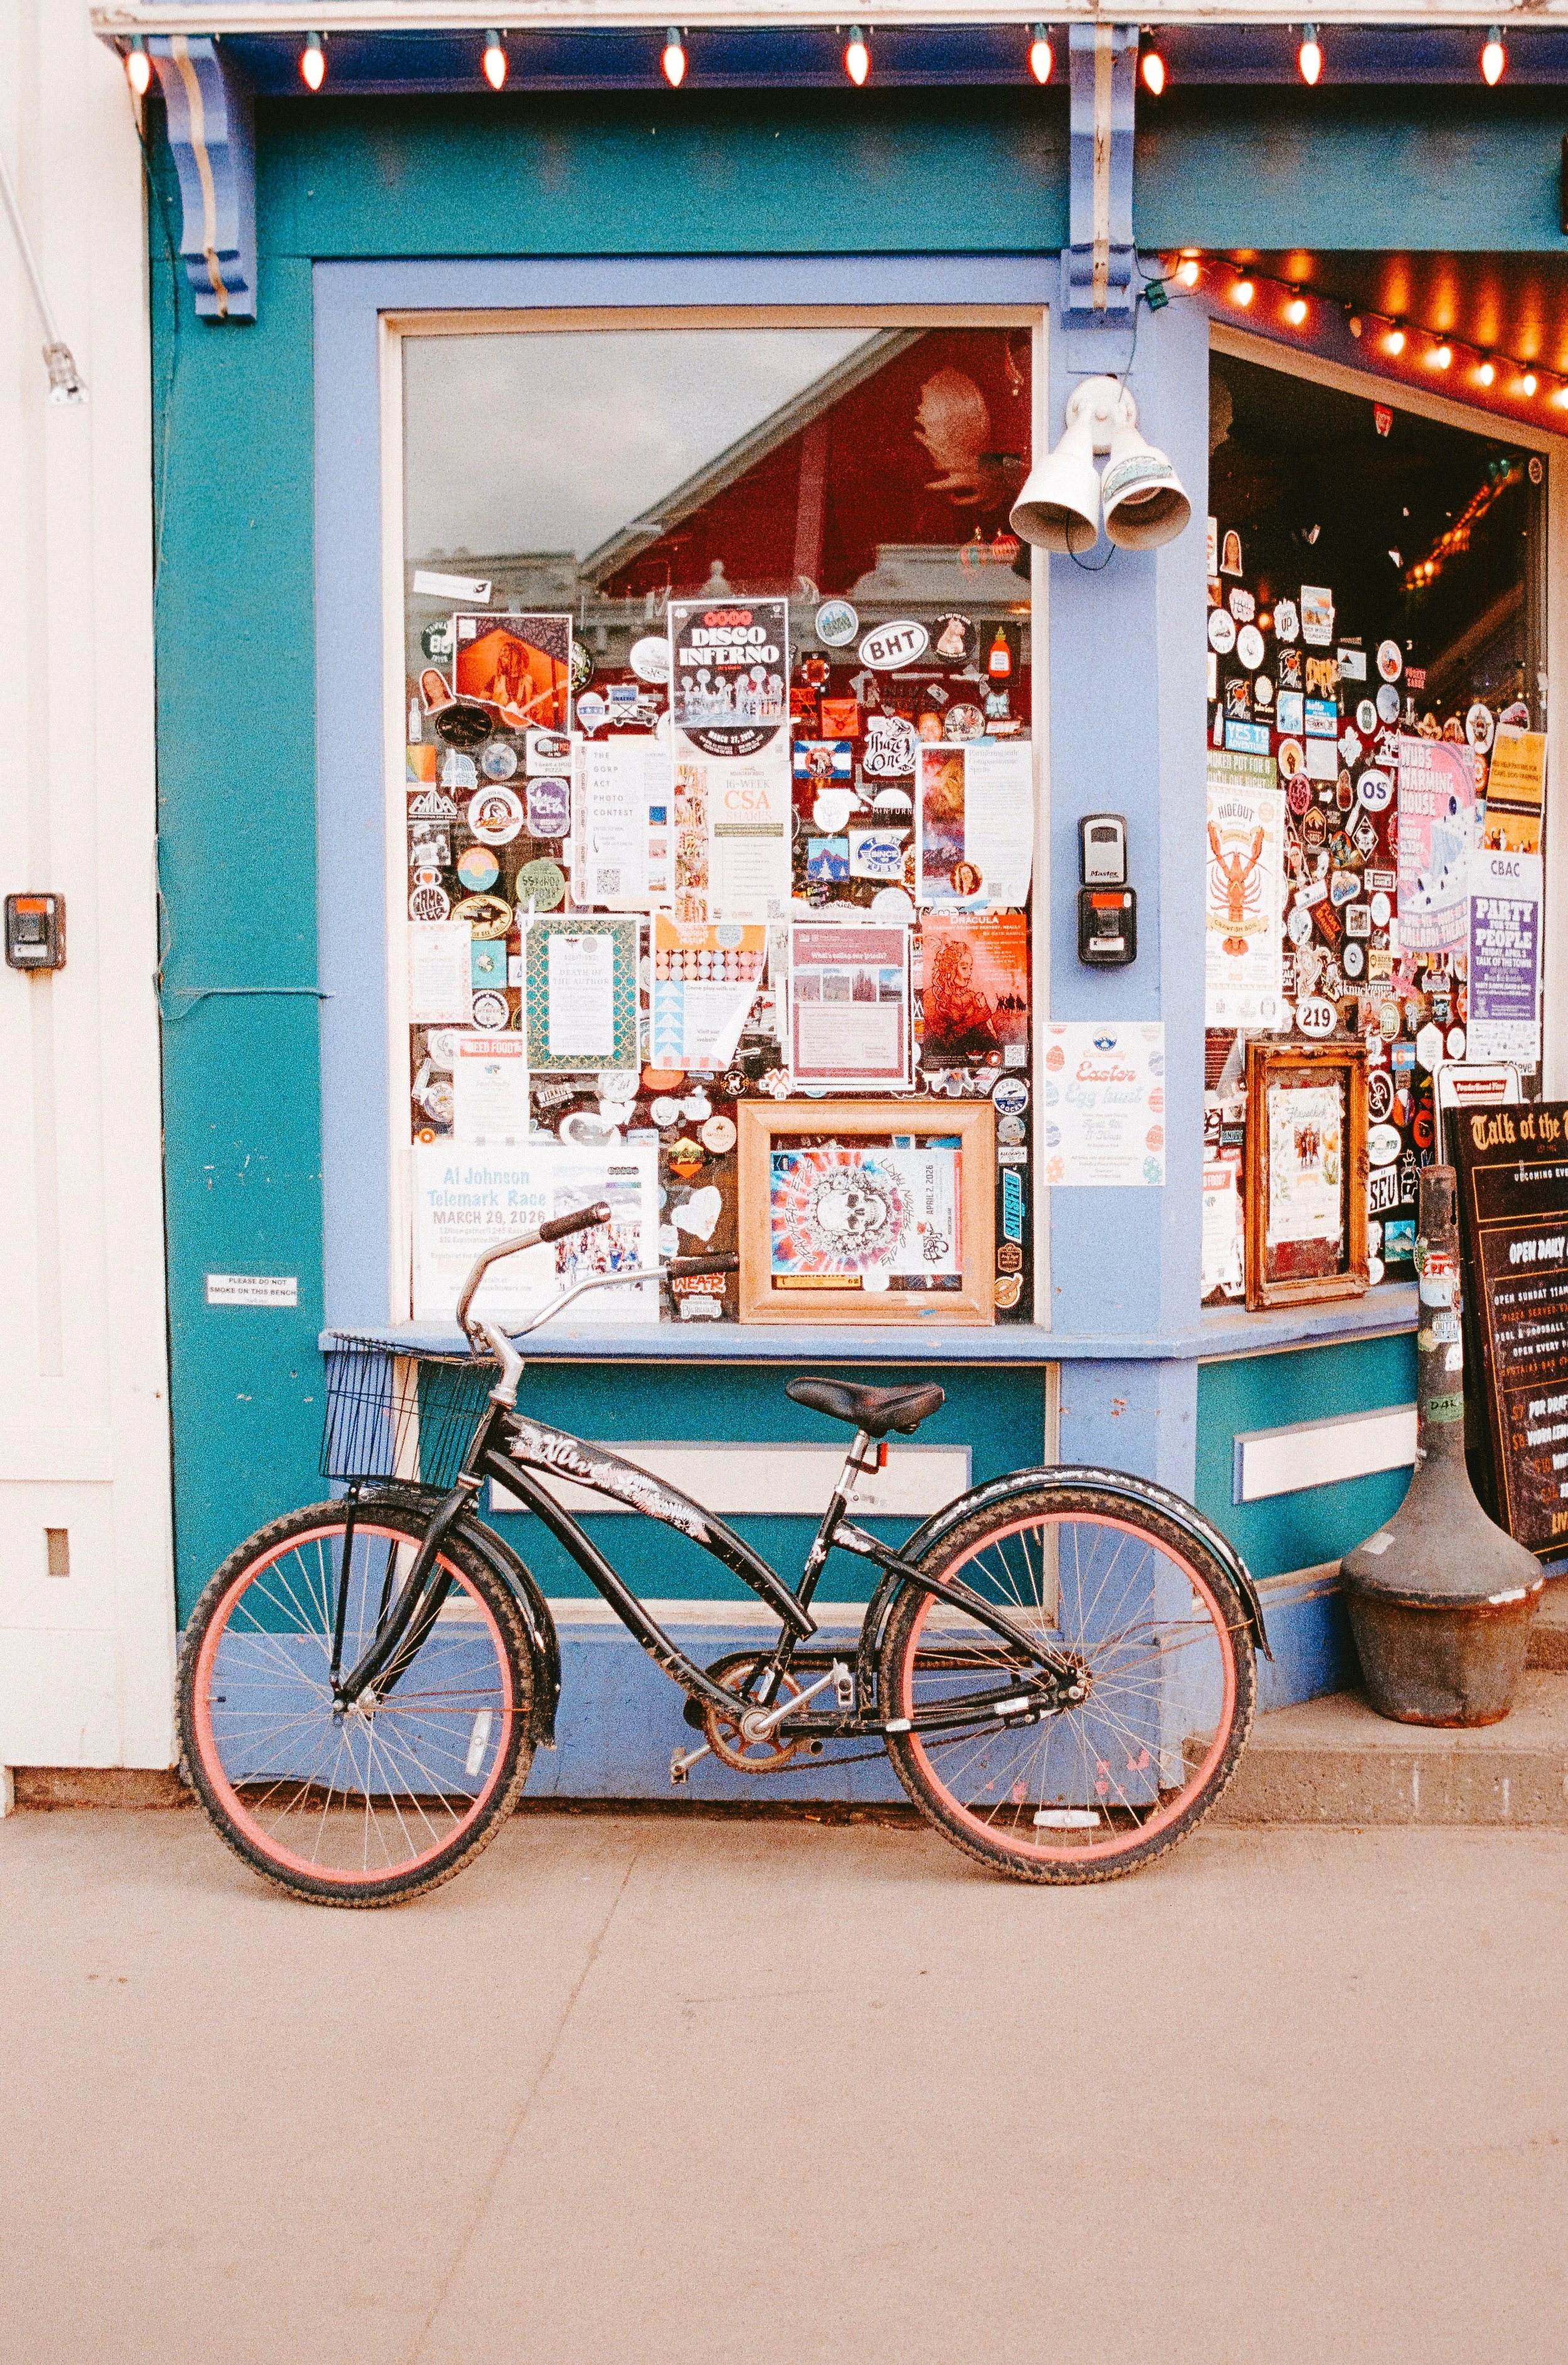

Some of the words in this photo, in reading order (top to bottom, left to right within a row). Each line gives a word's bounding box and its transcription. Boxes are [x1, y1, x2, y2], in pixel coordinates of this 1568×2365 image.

[1281, 617, 1292, 632] UP
[692, 627, 766, 647] DISCO
[869, 630, 916, 662] BHT
[680, 645, 780, 666] INFERNO
[707, 730, 728, 743] MARCH
[1227, 723, 1249, 739] YES
[1253, 726, 1269, 740] TO
[726, 780, 770, 789] 16-WEEK
[1363, 782, 1387, 800] OS
[724, 790, 771, 810] CSA
[1400, 790, 1436, 817] HOUSE
[1217, 802, 1255, 822] HIDEOUT
[1490, 859, 1520, 878] CBAC
[1321, 902, 1342, 932] FLOAT
[1475, 898, 1534, 923] PARTY
[950, 916, 999, 924] DRACULA
[1214, 919, 1242, 933] CRAWFISH
[1475, 928, 1533, 949] PEOPLE
[1476, 955, 1491, 966] TALK
[1491, 957, 1501, 967] OF
[1512, 958, 1532, 969] TOWN
[1303, 1007, 1330, 1028] 219
[1075, 1060, 1136, 1082] Easter
[998, 1082, 1023, 1093] HARBOR
[1065, 1081, 1098, 1108] Egg
[1101, 1085, 1144, 1105] hunt
[1000, 1103, 1023, 1113] DOCKS
[1471, 1113, 1517, 1151] Talk
[1520, 1112, 1537, 1140] of
[1539, 1112, 1560, 1143] the
[443, 1167, 460, 1185] Al
[465, 1167, 530, 1185] Johnson
[926, 1164, 934, 1185] 2026
[427, 1189, 499, 1207] Telemark
[507, 1189, 546, 1207] Race
[926, 1196, 934, 1215] APRIL
[1005, 1173, 1020, 1239] SATISFIED
[433, 1211, 481, 1224] MARCH
[510, 1211, 546, 1224] 2026
[1509, 1240, 1536, 1264] OPEN
[1537, 1236, 1565, 1261] DAILY
[229, 1277, 257, 1285] PLEASE
[1494, 1293, 1515, 1306] OPEN
[1518, 1288, 1547, 1302] SUNDAY
[1435, 1322, 1457, 1331] OUTTA
[1513, 1346, 1534, 1358] OPEN
[1536, 1341, 1559, 1353] EVERY
[1512, 1404, 1525, 1421] $7
